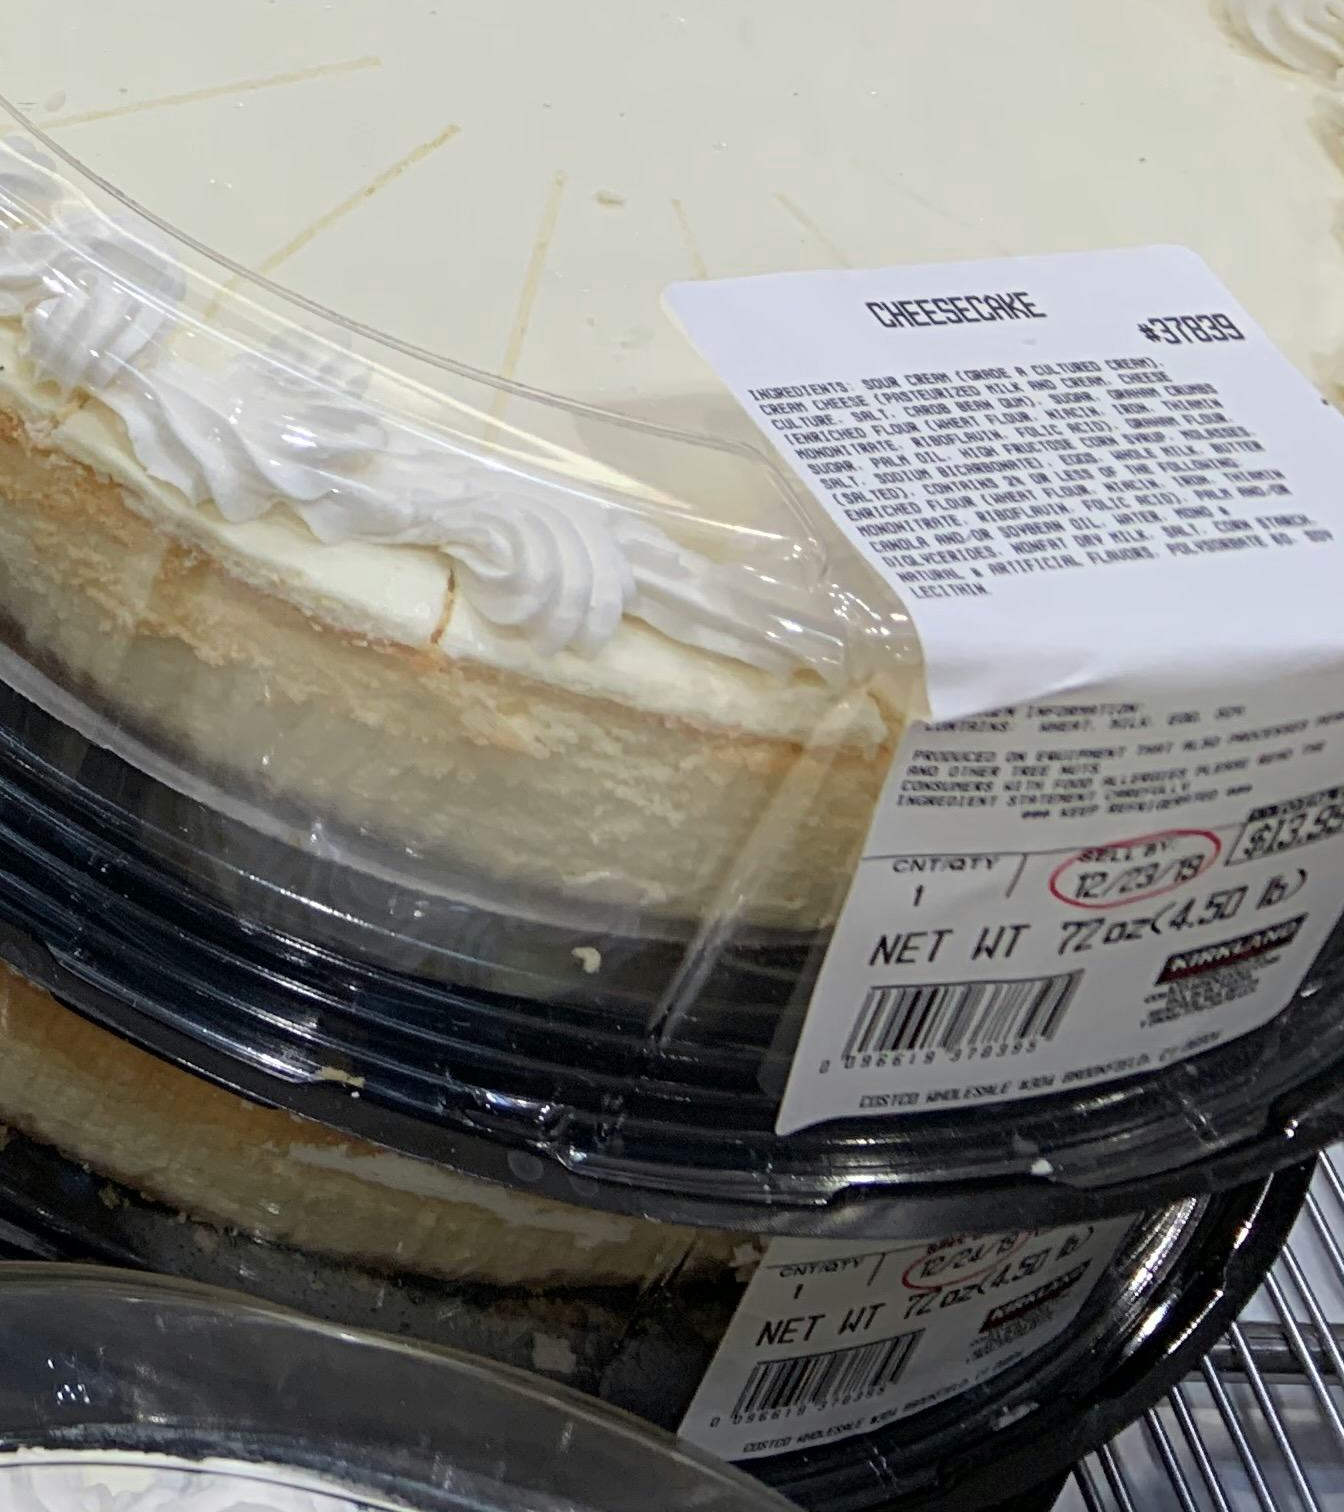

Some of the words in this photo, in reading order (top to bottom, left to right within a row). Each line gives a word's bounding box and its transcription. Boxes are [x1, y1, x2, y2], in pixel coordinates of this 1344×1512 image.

[866, 292, 1047, 329] CHEESECAKE
[1138, 313, 1246, 344] #37839
[892, 856, 1000, 878] CNT/QTY
[1074, 854, 1205, 900] 12/23/19
[869, 929, 954, 966] NET
[971, 923, 1031, 961] WT
[1058, 916, 1108, 956] 72
[755, 1314, 827, 1346] NET
[838, 1302, 887, 1335] WT
